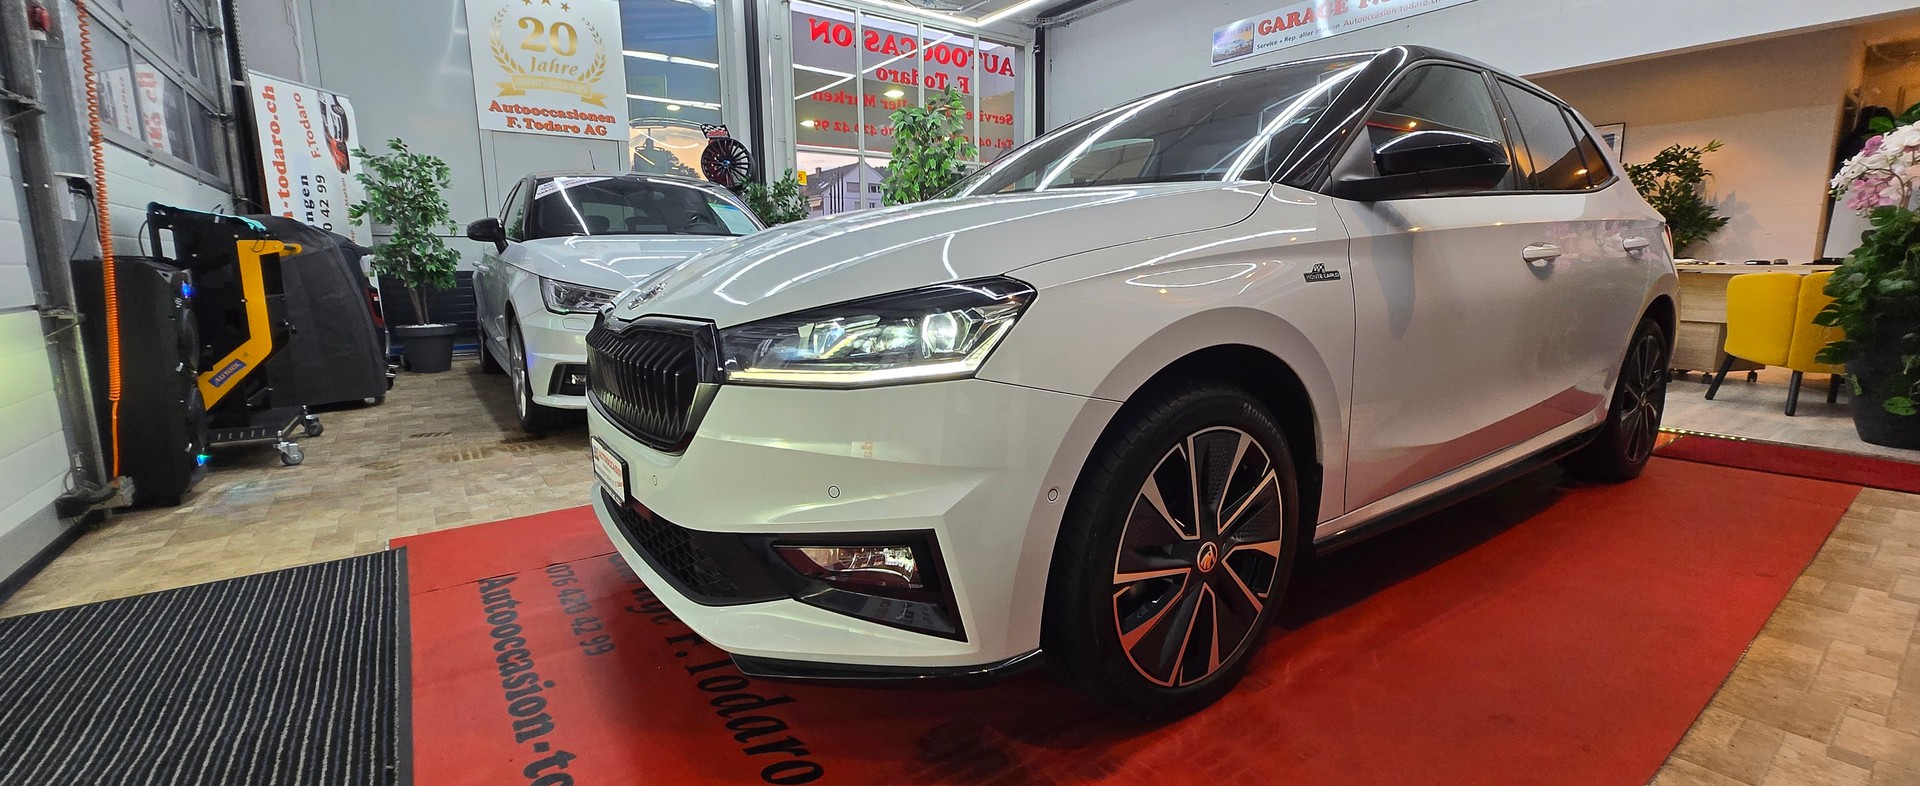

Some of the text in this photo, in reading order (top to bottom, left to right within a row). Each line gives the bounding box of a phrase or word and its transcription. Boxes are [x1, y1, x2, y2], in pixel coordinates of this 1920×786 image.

[517, 16, 578, 57] 20
[1256, 39, 1278, 50] Service
[529, 56, 579, 76] Jahre
[488, 99, 617, 124] Autooccasionen
[506, 115, 608, 136] F. Todaro AG
[316, 174, 328, 194] 99
[318, 199, 331, 218] 42
[545, 563, 569, 588] 076
